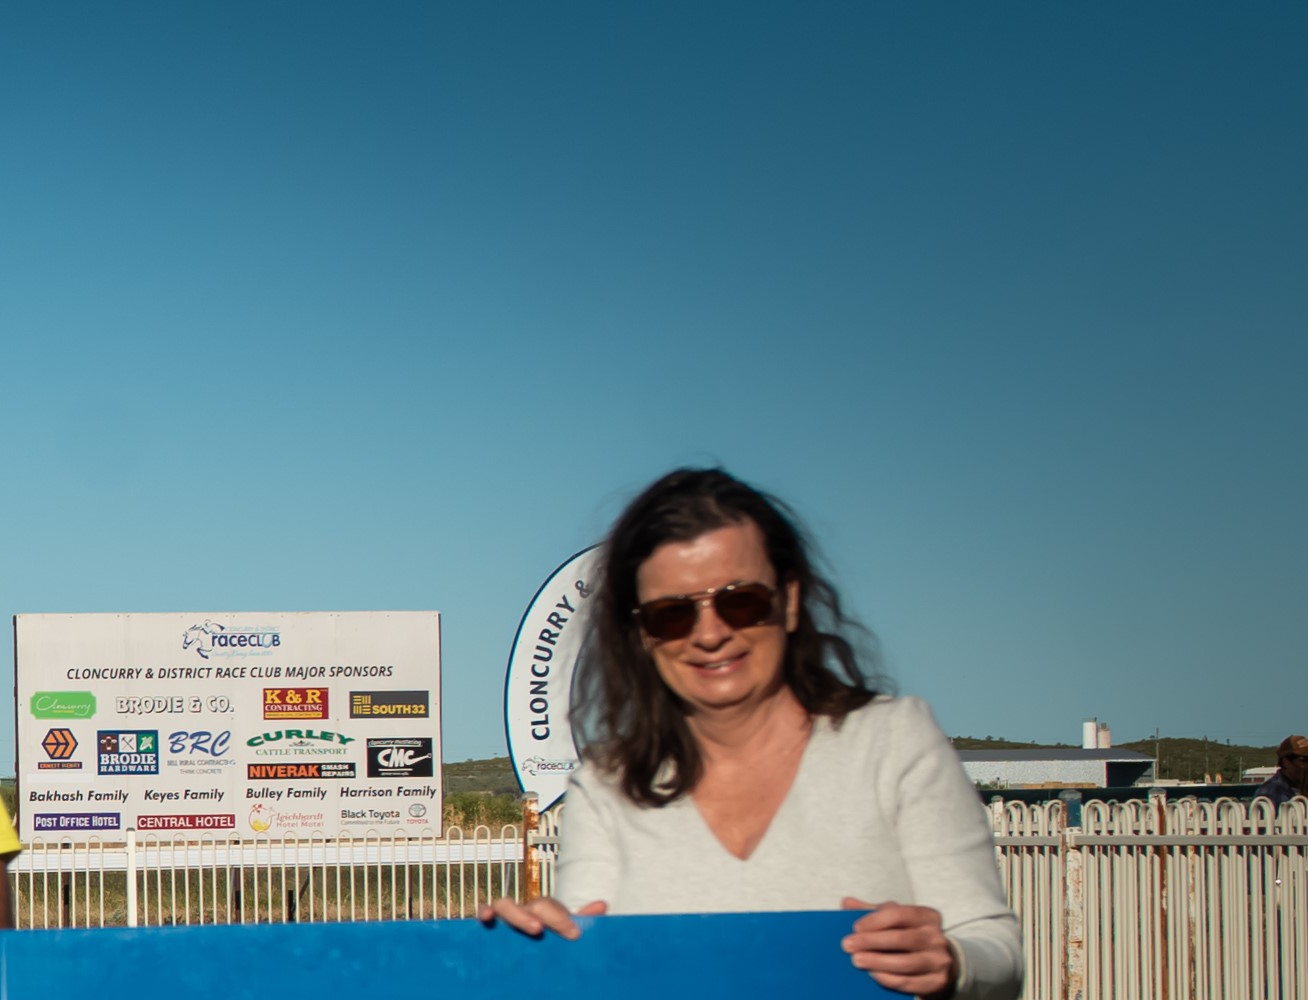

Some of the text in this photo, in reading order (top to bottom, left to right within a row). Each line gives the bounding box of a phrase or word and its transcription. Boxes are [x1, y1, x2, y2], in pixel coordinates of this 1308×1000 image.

[529, 579, 592, 741] CLONCURRY &
[67, 665, 393, 680] CLONCURRY & DISTRICT RACE CLUB MAJOR SPONSORS
[264, 689, 322, 704] K & R
[116, 695, 234, 715] BRODIE & CO.
[264, 703, 323, 712] CONTRACTING
[372, 704, 426, 715] SOUTH32
[167, 730, 231, 757] BRC
[246, 729, 355, 747] CURLEY
[100, 753, 156, 764] BRODIE
[256, 747, 348, 756] CATTLE TRANSPORT
[377, 748, 431, 768] CMC
[249, 765, 320, 777] NIVERAK
[29, 789, 129, 803] Bakhash Family
[144, 788, 225, 803] Keyes Family
[245, 787, 328, 802] Bulley Family
[339, 785, 437, 799] Harrison Family
[341, 809, 400, 820] Black Toyota
[138, 815, 234, 829] CENTRAL HOTEL
